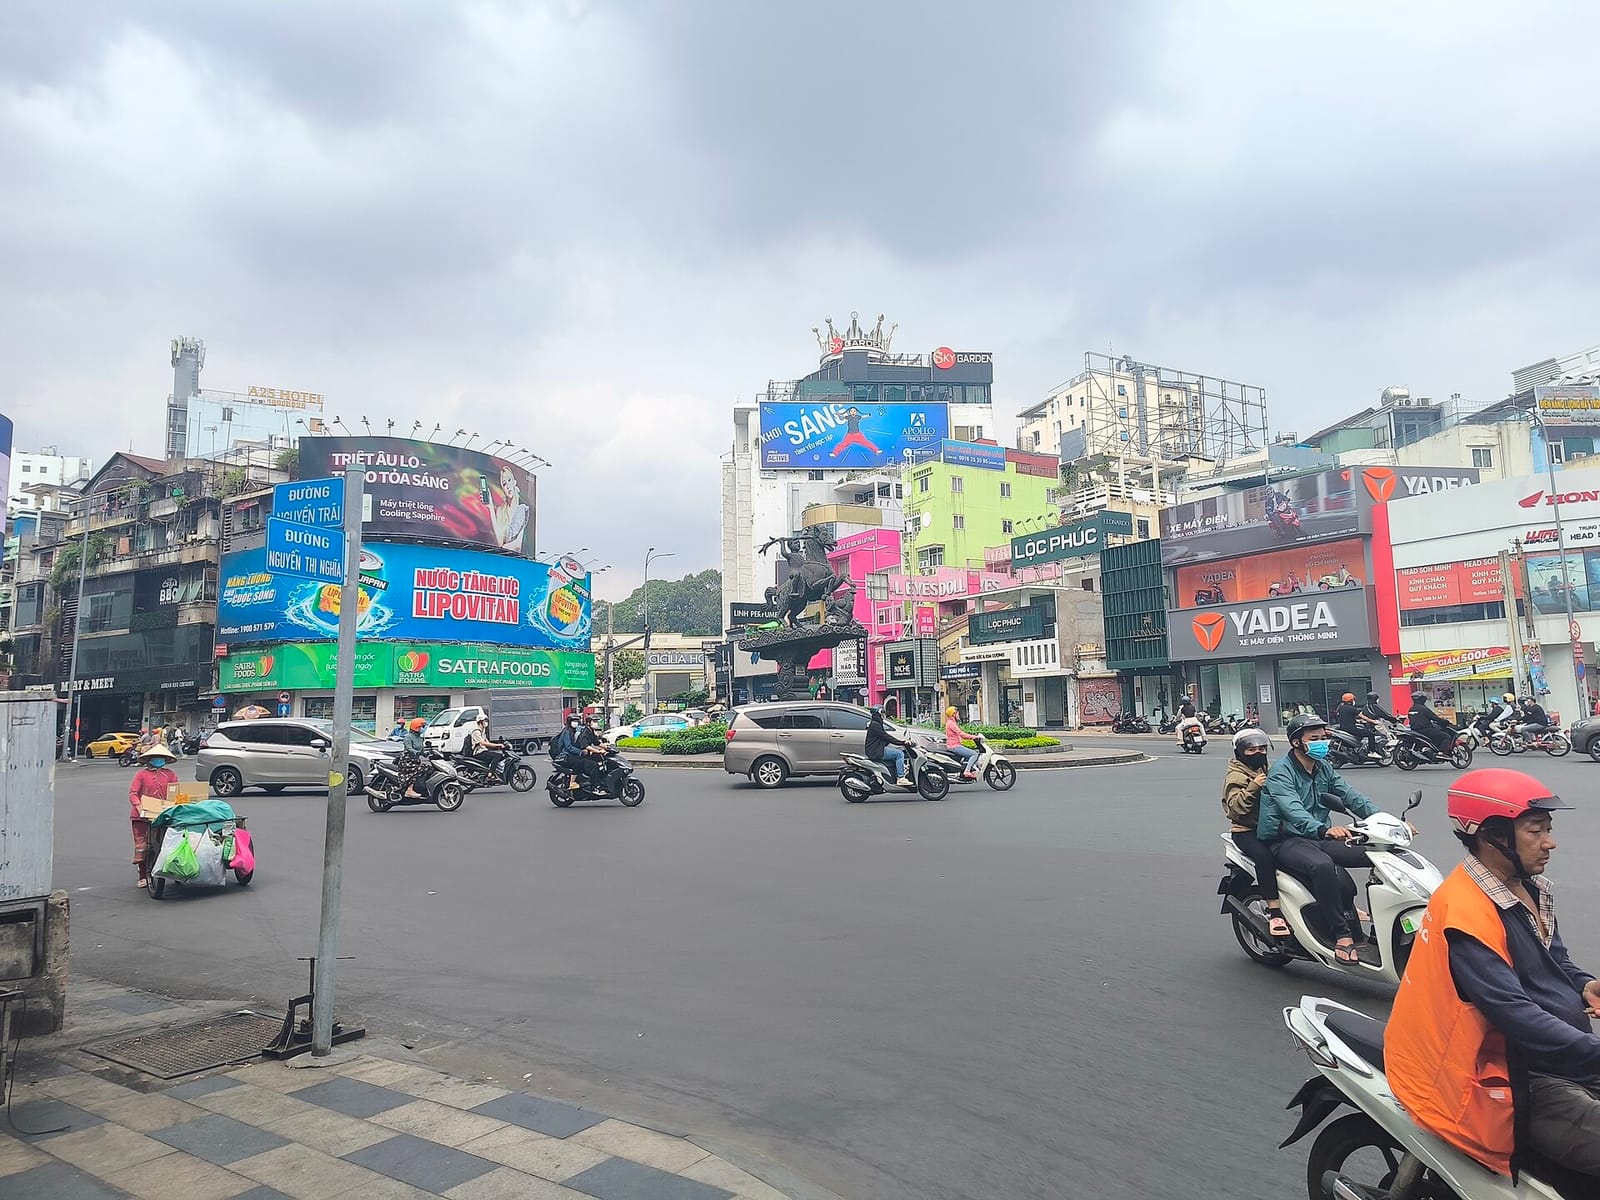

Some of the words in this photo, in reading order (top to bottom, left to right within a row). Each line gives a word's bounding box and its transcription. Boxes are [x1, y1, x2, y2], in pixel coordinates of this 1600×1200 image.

[934, 351, 955, 364] SKY
[956, 353, 993, 363] GARDEN
[280, 390, 324, 404] HOTEL
[784, 404, 849, 445] SÁNG
[902, 427, 936, 435] APOLLO
[375, 450, 397, 467] ÂU
[400, 455, 420, 469] LO
[767, 454, 789, 462] ACTIVE
[412, 469, 449, 490] SÁNG
[288, 485, 330, 501] ĐƯỜNG
[380, 499, 397, 508] Máy
[318, 502, 341, 522] TRÃI
[380, 509, 411, 519] Cooling
[412, 511, 446, 521] Sapphire
[1170, 524, 1181, 533] XE
[1183, 519, 1203, 530] MÁY
[1205, 513, 1228, 526] ĐIỆN
[285, 529, 330, 549] ĐƯỜNG
[1570, 532, 1594, 540] HEAD
[1014, 538, 1047, 560] LỘC
[1049, 527, 1097, 552] PHÚC
[269, 549, 301, 571] NGUYỄN
[305, 556, 317, 577] THỊ
[320, 558, 342, 578] NGHĨA
[1463, 560, 1482, 568] HEAD
[1202, 571, 1234, 583] YADEA
[1402, 568, 1418, 576] HEAD
[358, 575, 387, 590] JAPAN
[416, 568, 459, 589] NƯỚC
[462, 570, 496, 593] TĂNG
[500, 576, 519, 597] LỰC
[414, 592, 519, 624] LIPOVITAN
[734, 609, 749, 617] LINH
[1002, 615, 1022, 627] PHÚC
[1229, 601, 1338, 636] YADEA
[1250, 636, 1265, 645] MÁY
[1287, 632, 1315, 642] THÔNG
[1317, 632, 1338, 640] MINH
[649, 654, 687, 665] CICILIA
[1461, 649, 1490, 663] 500K
[234, 662, 256, 670] SATRA
[438, 659, 550, 677] SATRAFOODS
[234, 670, 256, 678] FOODS
[60, 680, 83, 692] MAT
[91, 677, 115, 690] MEET
